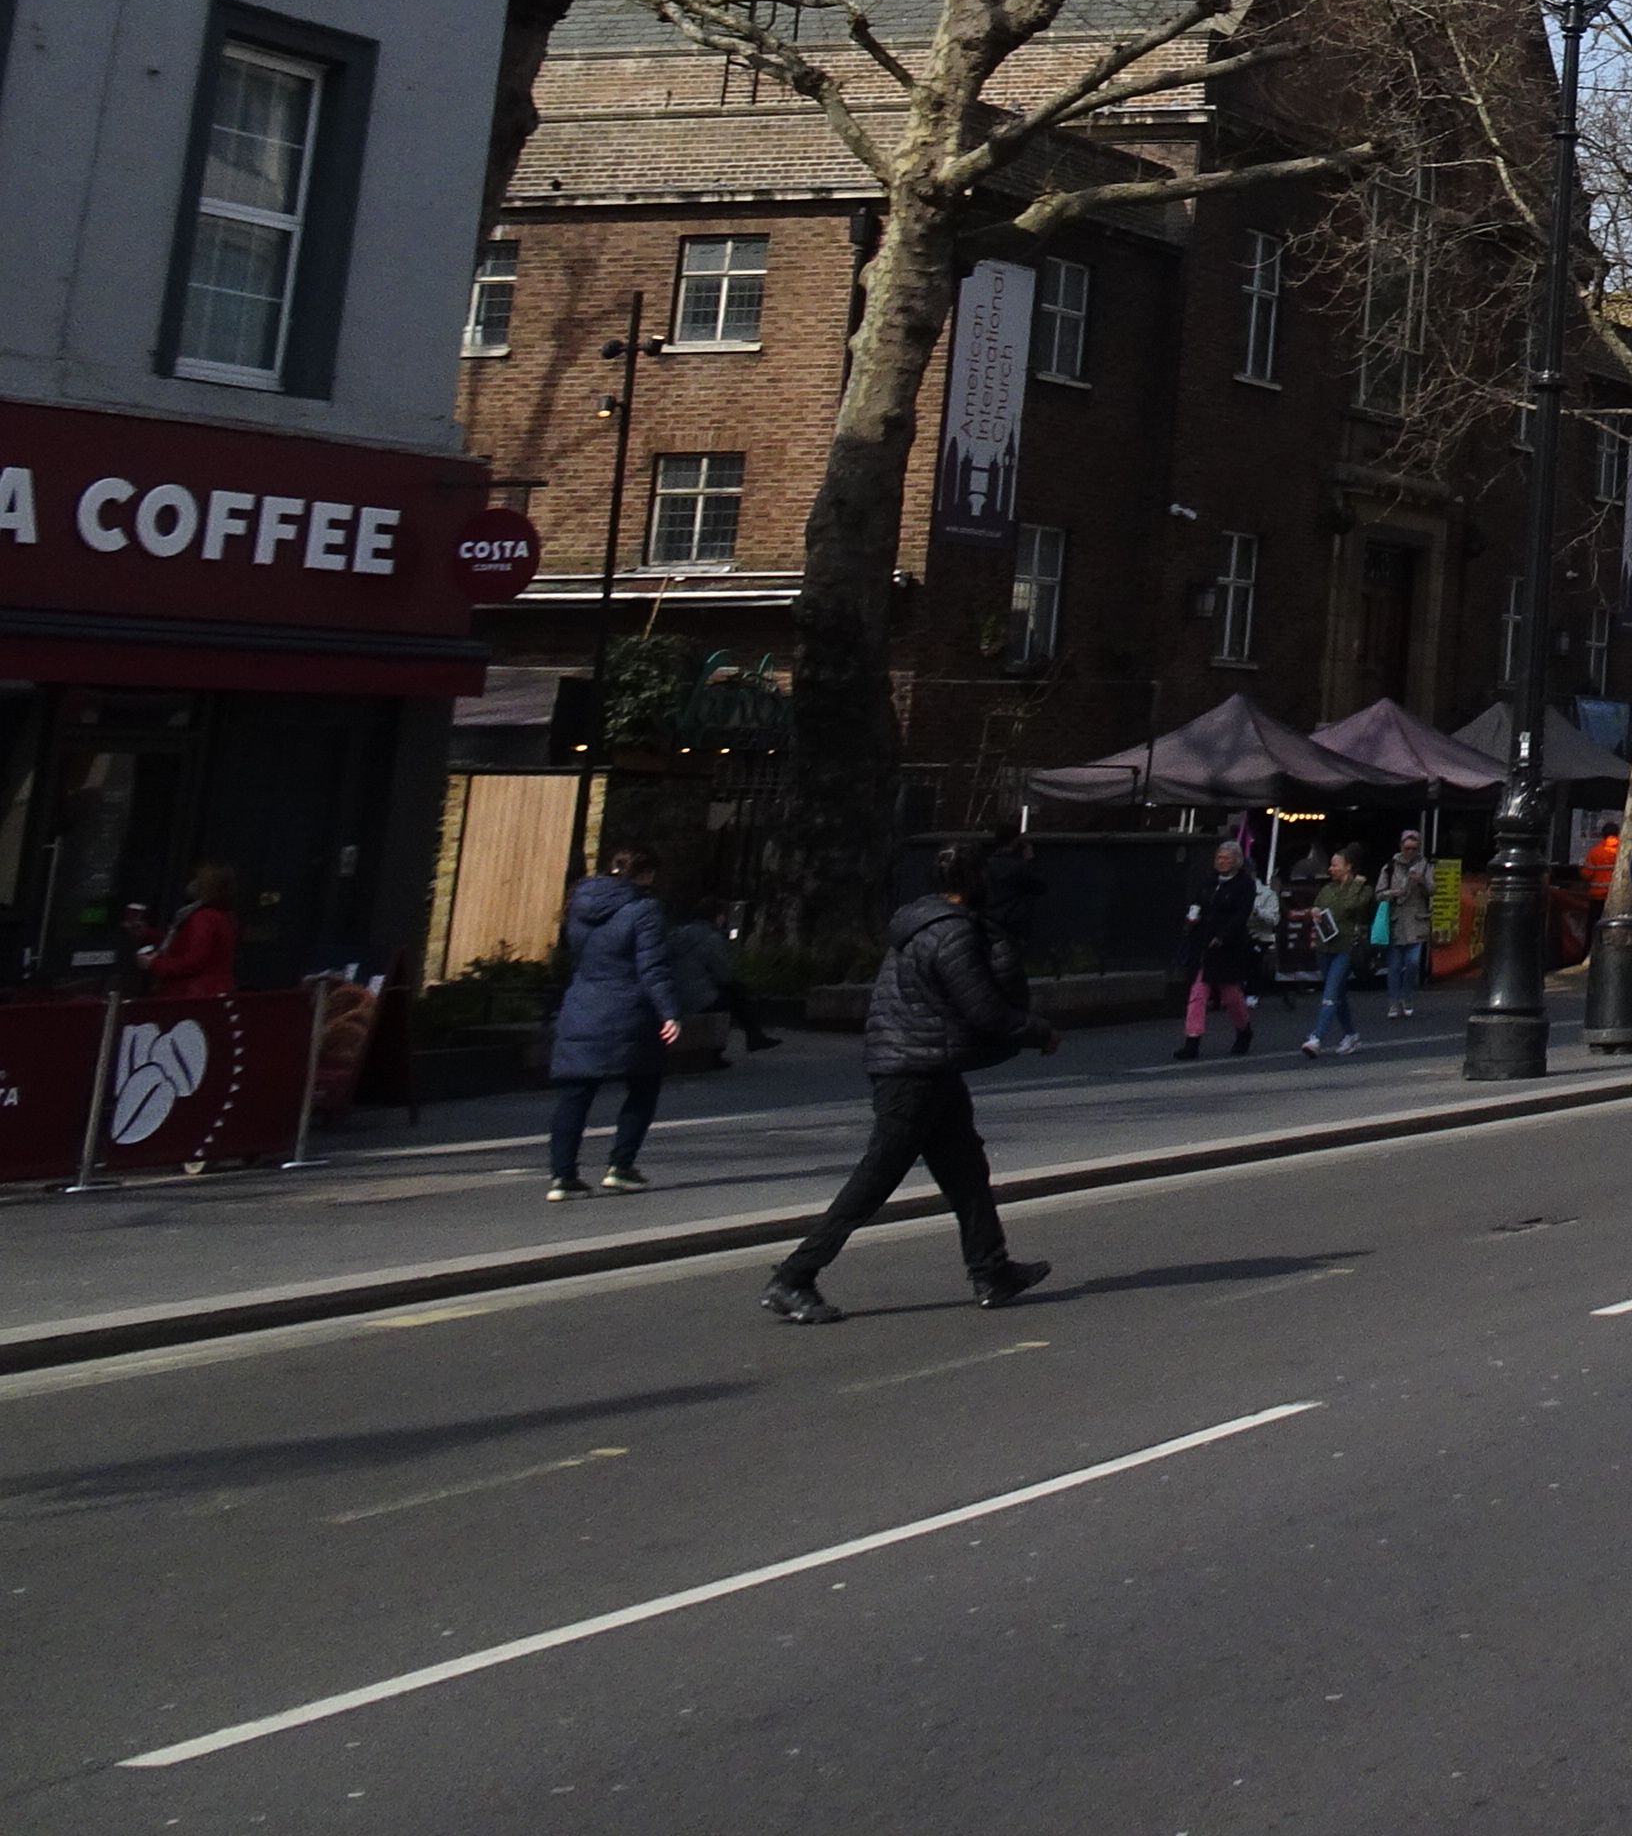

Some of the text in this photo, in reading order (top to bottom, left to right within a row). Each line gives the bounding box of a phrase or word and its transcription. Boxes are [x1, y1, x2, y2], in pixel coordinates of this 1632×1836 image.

[959, 303, 985, 439] American
[976, 268, 1007, 441] International
[991, 344, 1014, 445] Church
[77, 477, 401, 575] COFFEE
[459, 540, 530, 561] COSTA
[472, 563, 513, 572] COFFEE
